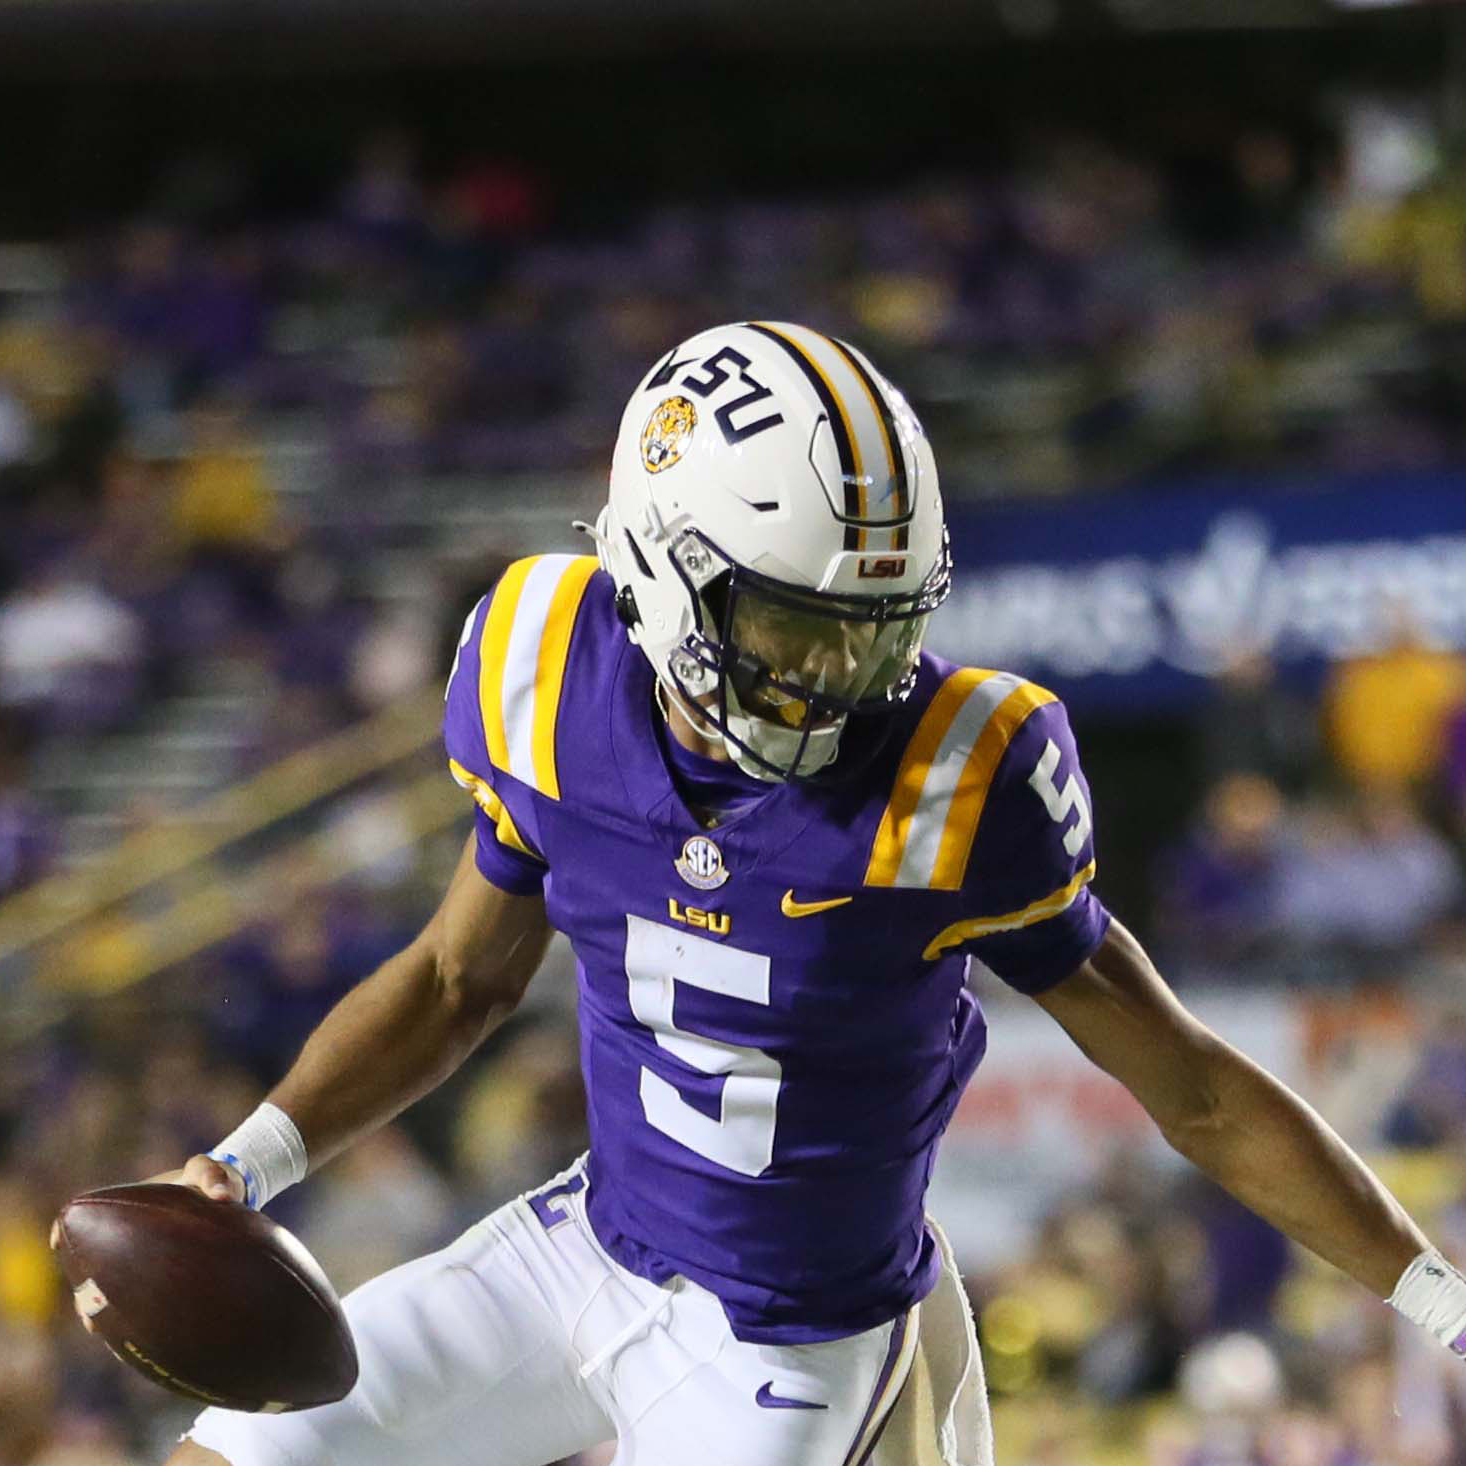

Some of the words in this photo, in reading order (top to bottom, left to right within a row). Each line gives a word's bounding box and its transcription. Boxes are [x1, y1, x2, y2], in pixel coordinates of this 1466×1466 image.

[645, 345, 784, 447] LSU
[857, 557, 907, 578] LSU
[1028, 736, 1091, 857] 5
[686, 839, 718, 877] SEC
[668, 897, 731, 935] LSU
[625, 912, 782, 1178] 5
